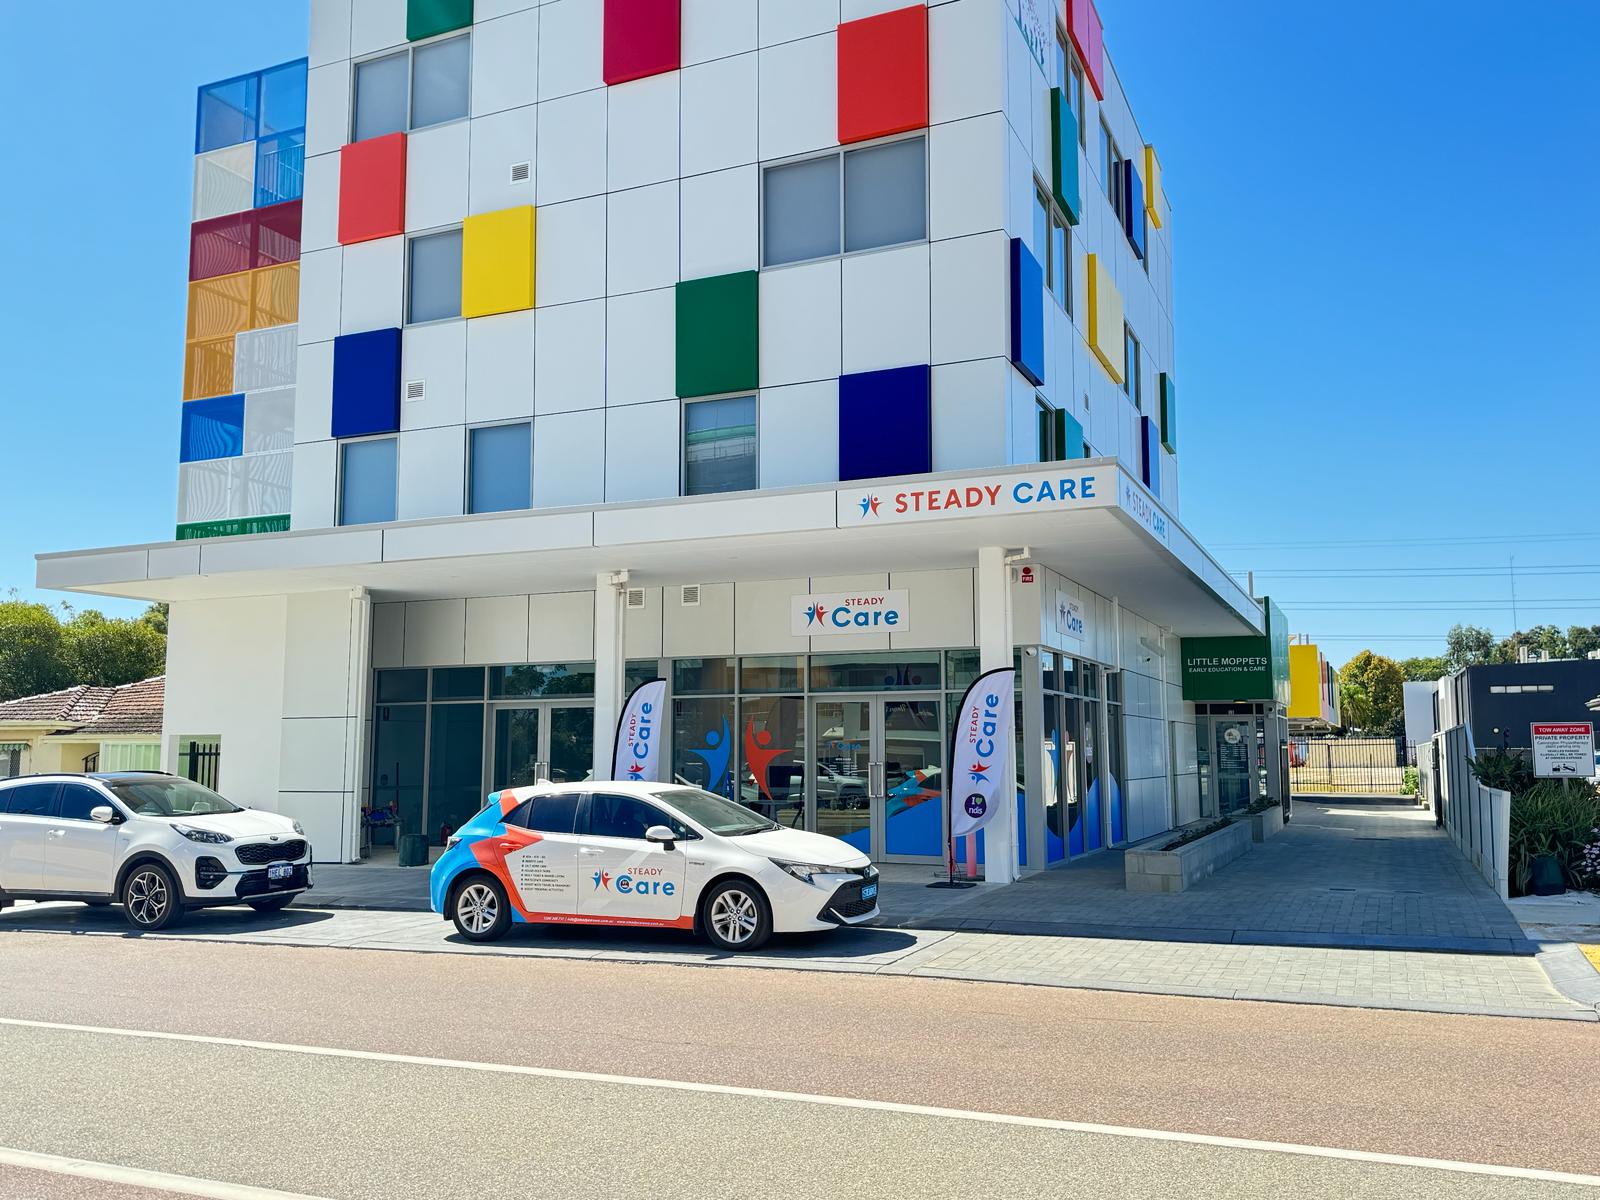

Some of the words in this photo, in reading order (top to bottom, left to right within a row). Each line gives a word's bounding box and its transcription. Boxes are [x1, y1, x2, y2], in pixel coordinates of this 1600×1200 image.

[895, 484, 1002, 514] STEADY
[1012, 476, 1096, 504] CARE
[844, 597, 885, 607] STEADY
[831, 606, 899, 628] Care
[1066, 609, 1083, 634] Care
[1187, 658, 1220, 666] LITTLE
[1221, 657, 1268, 665] MOPPETS
[628, 713, 637, 747] STEADY
[633, 702, 653, 759] Care
[969, 705, 980, 744] STEADY
[975, 693, 999, 758] Care
[968, 807, 983, 815] ndis
[627, 867, 664, 876] STEADY
[615, 875, 676, 896] Care
